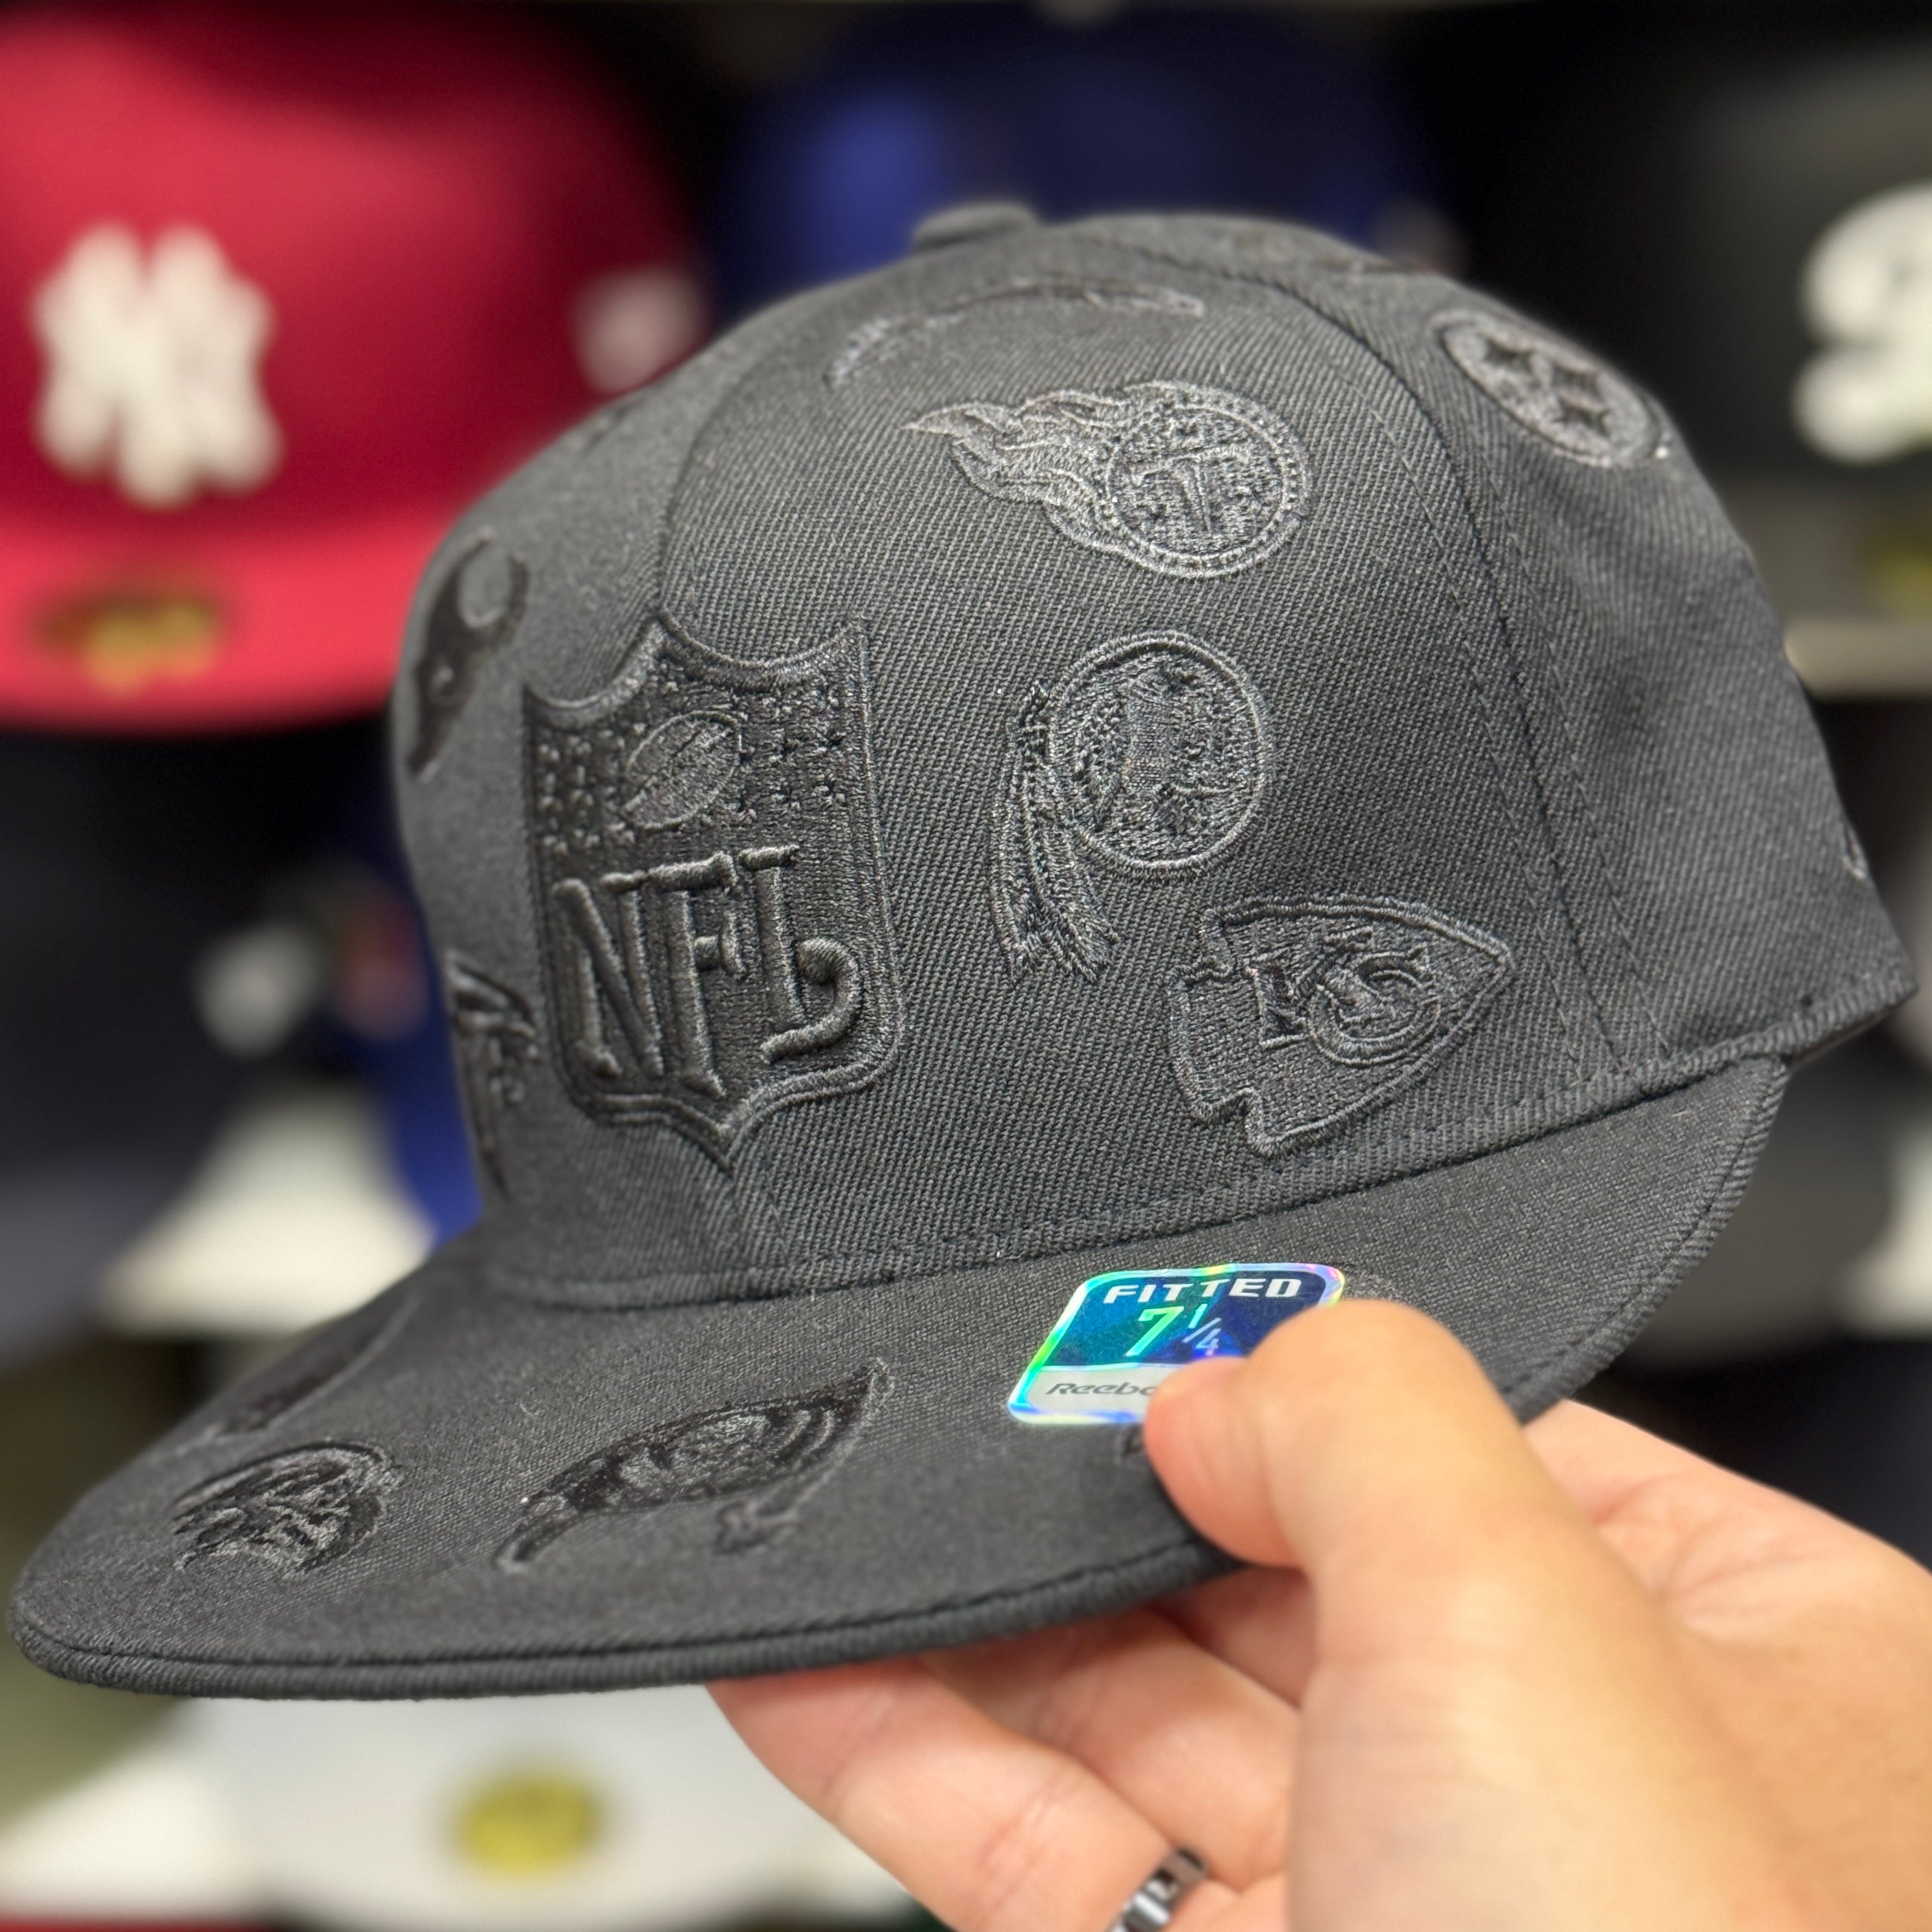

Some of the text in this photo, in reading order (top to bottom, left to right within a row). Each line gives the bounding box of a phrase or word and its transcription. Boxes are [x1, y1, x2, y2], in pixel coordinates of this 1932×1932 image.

[551, 843, 863, 1096] NFL
[1102, 1278, 1302, 1304] FITTED
[1045, 1381, 1157, 1396] Reebo
